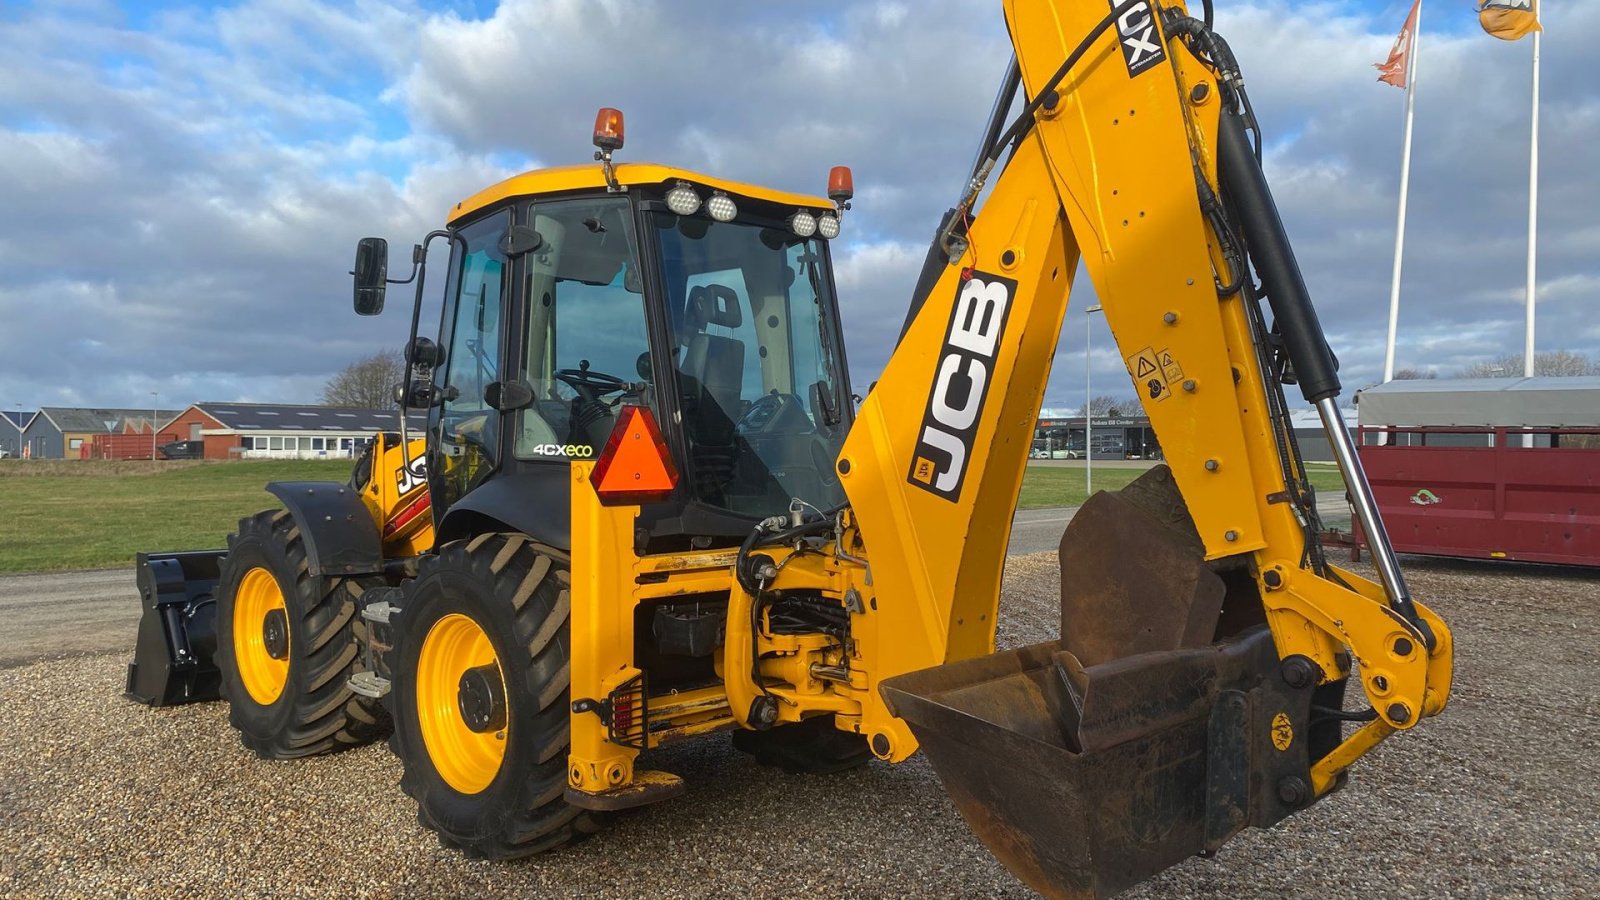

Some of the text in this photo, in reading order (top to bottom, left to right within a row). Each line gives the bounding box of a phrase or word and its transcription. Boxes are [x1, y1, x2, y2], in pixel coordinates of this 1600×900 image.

[1113, 0, 1161, 66] CX
[922, 278, 1008, 492] JCB
[398, 455, 428, 494] JC
